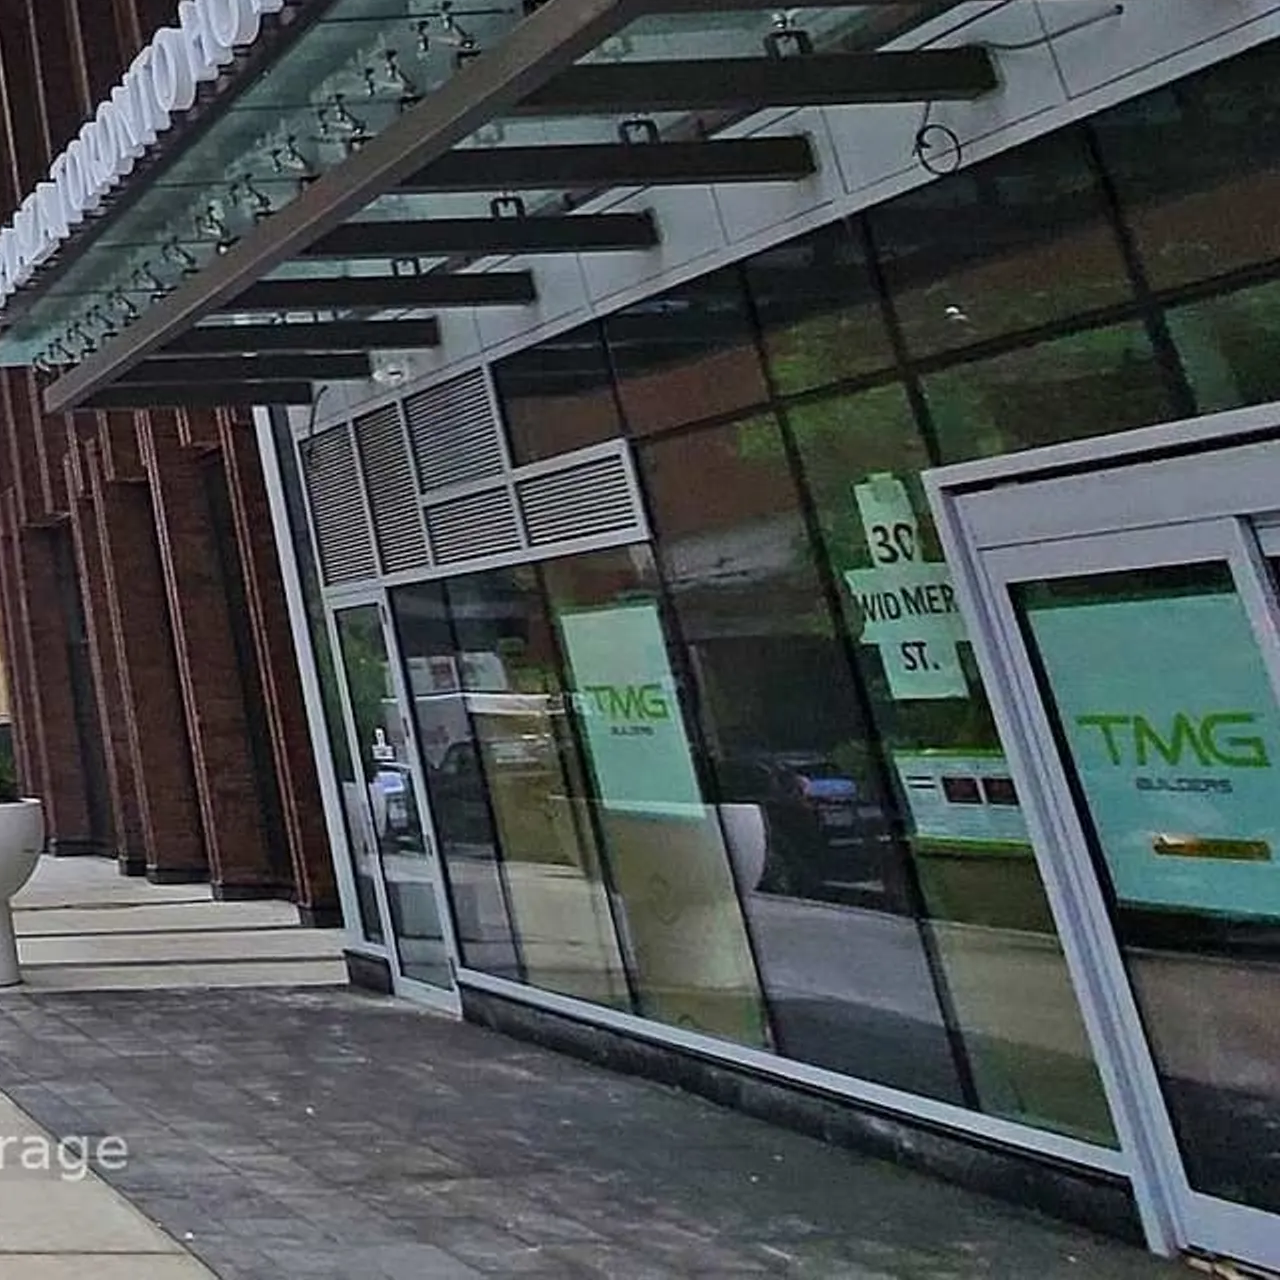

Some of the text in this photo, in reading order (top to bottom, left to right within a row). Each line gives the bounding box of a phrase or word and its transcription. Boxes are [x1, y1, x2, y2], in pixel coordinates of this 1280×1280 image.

[872, 522, 916, 563] 30
[901, 641, 941, 671] ST.
[583, 683, 671, 721] TMG
[1075, 711, 1272, 768] TMG
